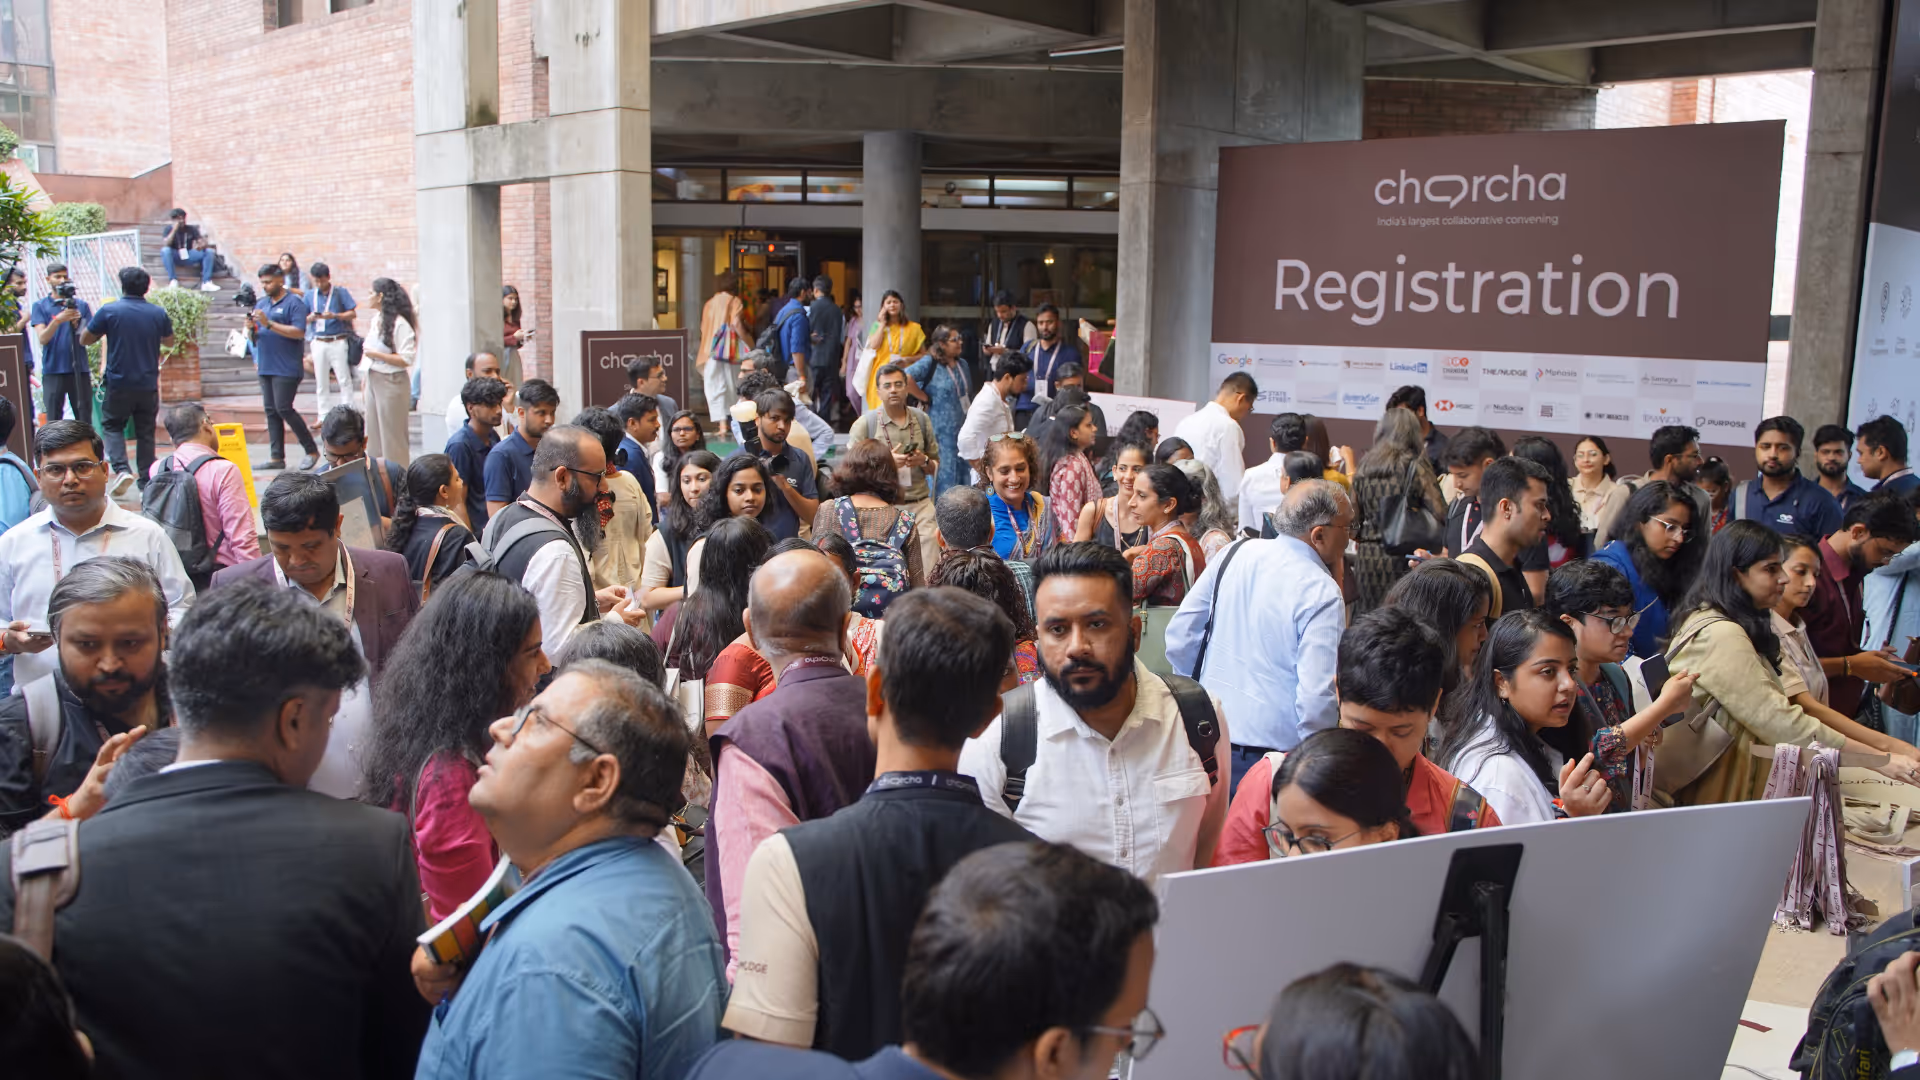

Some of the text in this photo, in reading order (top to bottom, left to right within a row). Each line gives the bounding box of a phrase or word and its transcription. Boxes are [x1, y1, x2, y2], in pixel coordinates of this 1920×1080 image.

[1377, 213, 1559, 228] India's largest collaborative convening
[1274, 254, 1680, 326] Registration
[1217, 353, 1252, 368] Google
[1707, 418, 1747, 429] PURPOSE
